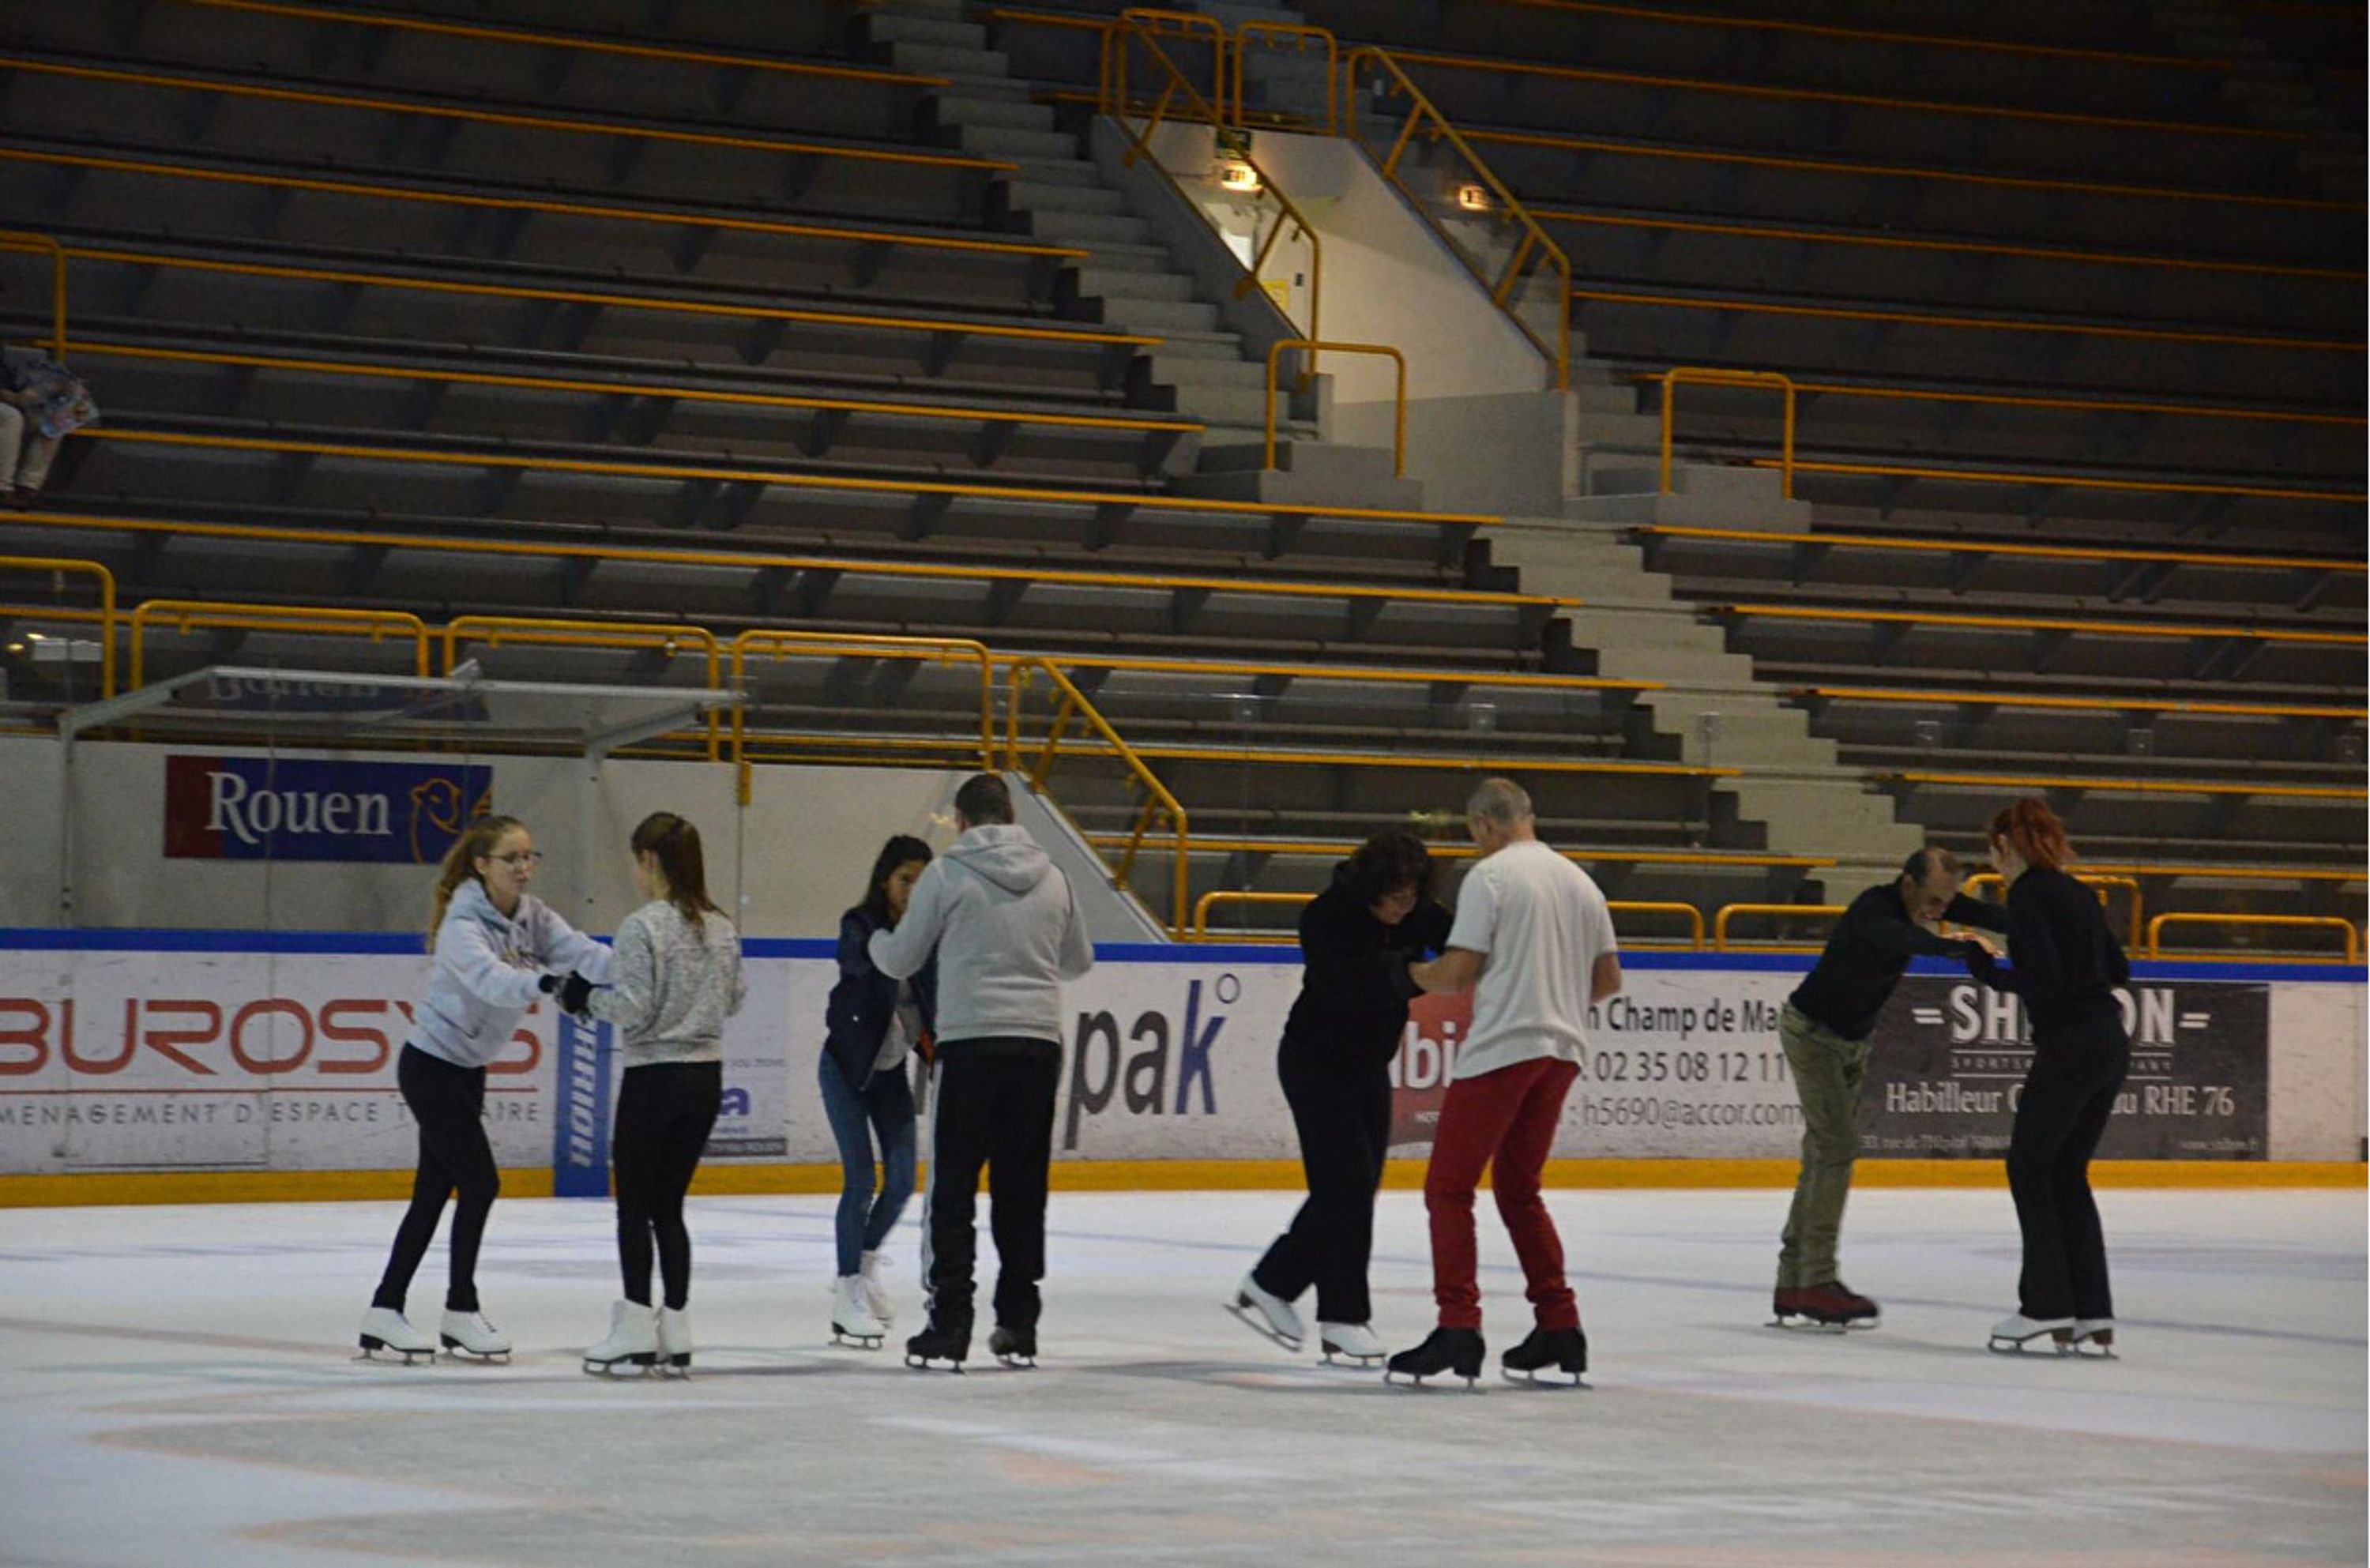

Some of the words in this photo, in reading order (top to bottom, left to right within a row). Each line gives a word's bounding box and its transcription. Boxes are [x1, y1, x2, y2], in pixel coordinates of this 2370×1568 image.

[204, 771, 393, 844] Rouen
[0, 998, 541, 1075] BUROS
[1608, 996, 1696, 1041] Champ
[1704, 998, 1735, 1032] de
[1741, 1000, 1778, 1033] Ma
[1596, 1051, 1627, 1081] 02
[1636, 1051, 1668, 1081] 35
[1676, 1051, 1709, 1081] 08
[1718, 1052, 1748, 1081] 12
[1759, 1052, 1785, 1081] 11
[1886, 1081, 2003, 1113] Habilleur
[2144, 1086, 2197, 1115] RHE
[2203, 1086, 2235, 1116] 76
